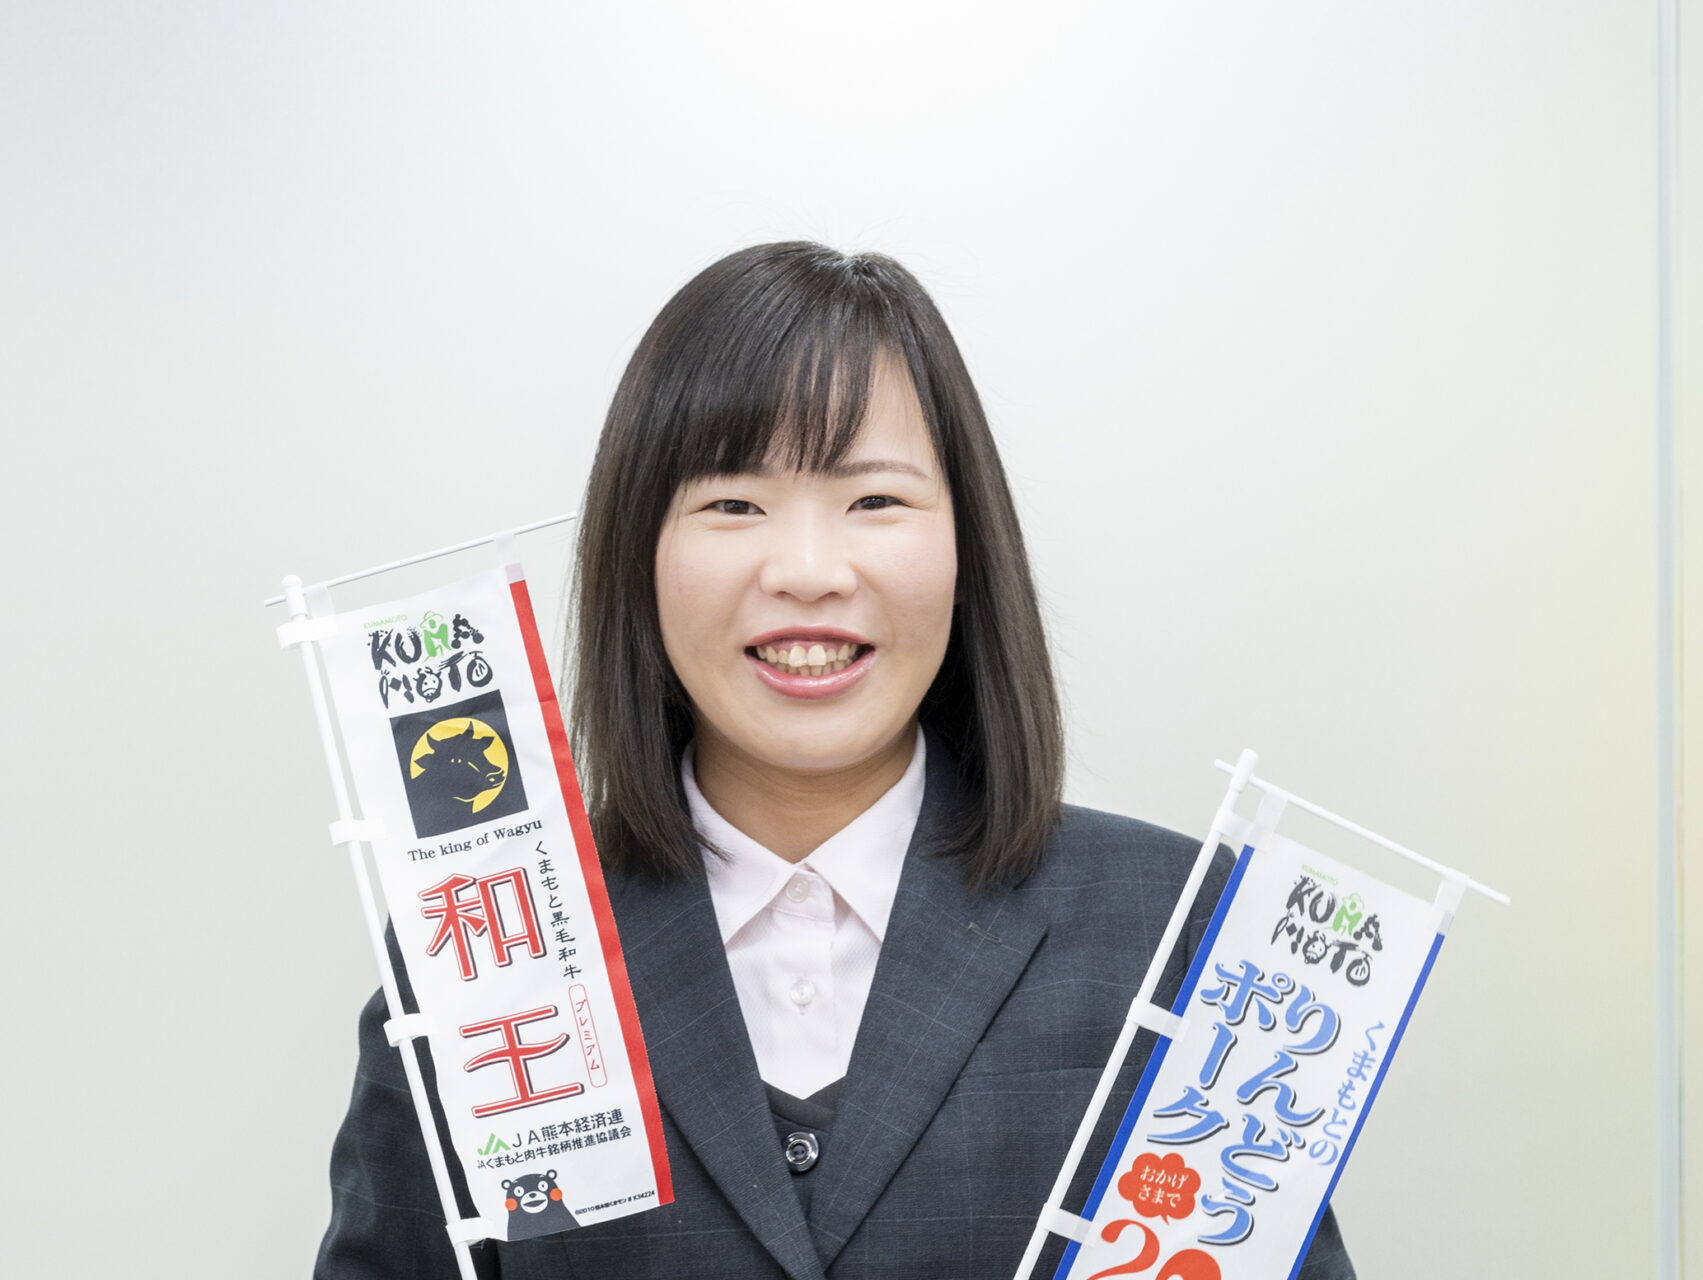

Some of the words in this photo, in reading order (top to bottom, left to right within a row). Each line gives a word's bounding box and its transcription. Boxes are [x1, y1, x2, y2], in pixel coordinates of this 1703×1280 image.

[367, 611, 484, 670] KUMA
[379, 651, 493, 709] MOTO
[408, 848, 436, 861] The
[440, 841, 472, 856] king
[476, 833, 490, 846] of
[493, 819, 543, 839] Wagyu
[535, 840, 582, 979] くまもと黒毛和牛
[1286, 875, 1382, 951] KUMA
[1271, 909, 1373, 987] MOTO
[576, 999, 600, 1071] プレミアム
[1147, 959, 1295, 1145] ポーク
[1198, 984, 1341, 1246] りんどう
[1309, 1021, 1385, 1166] くまもとの
[1138, 1184, 1181, 1208] さまで
[1140, 1165, 1189, 1189] おかげ
